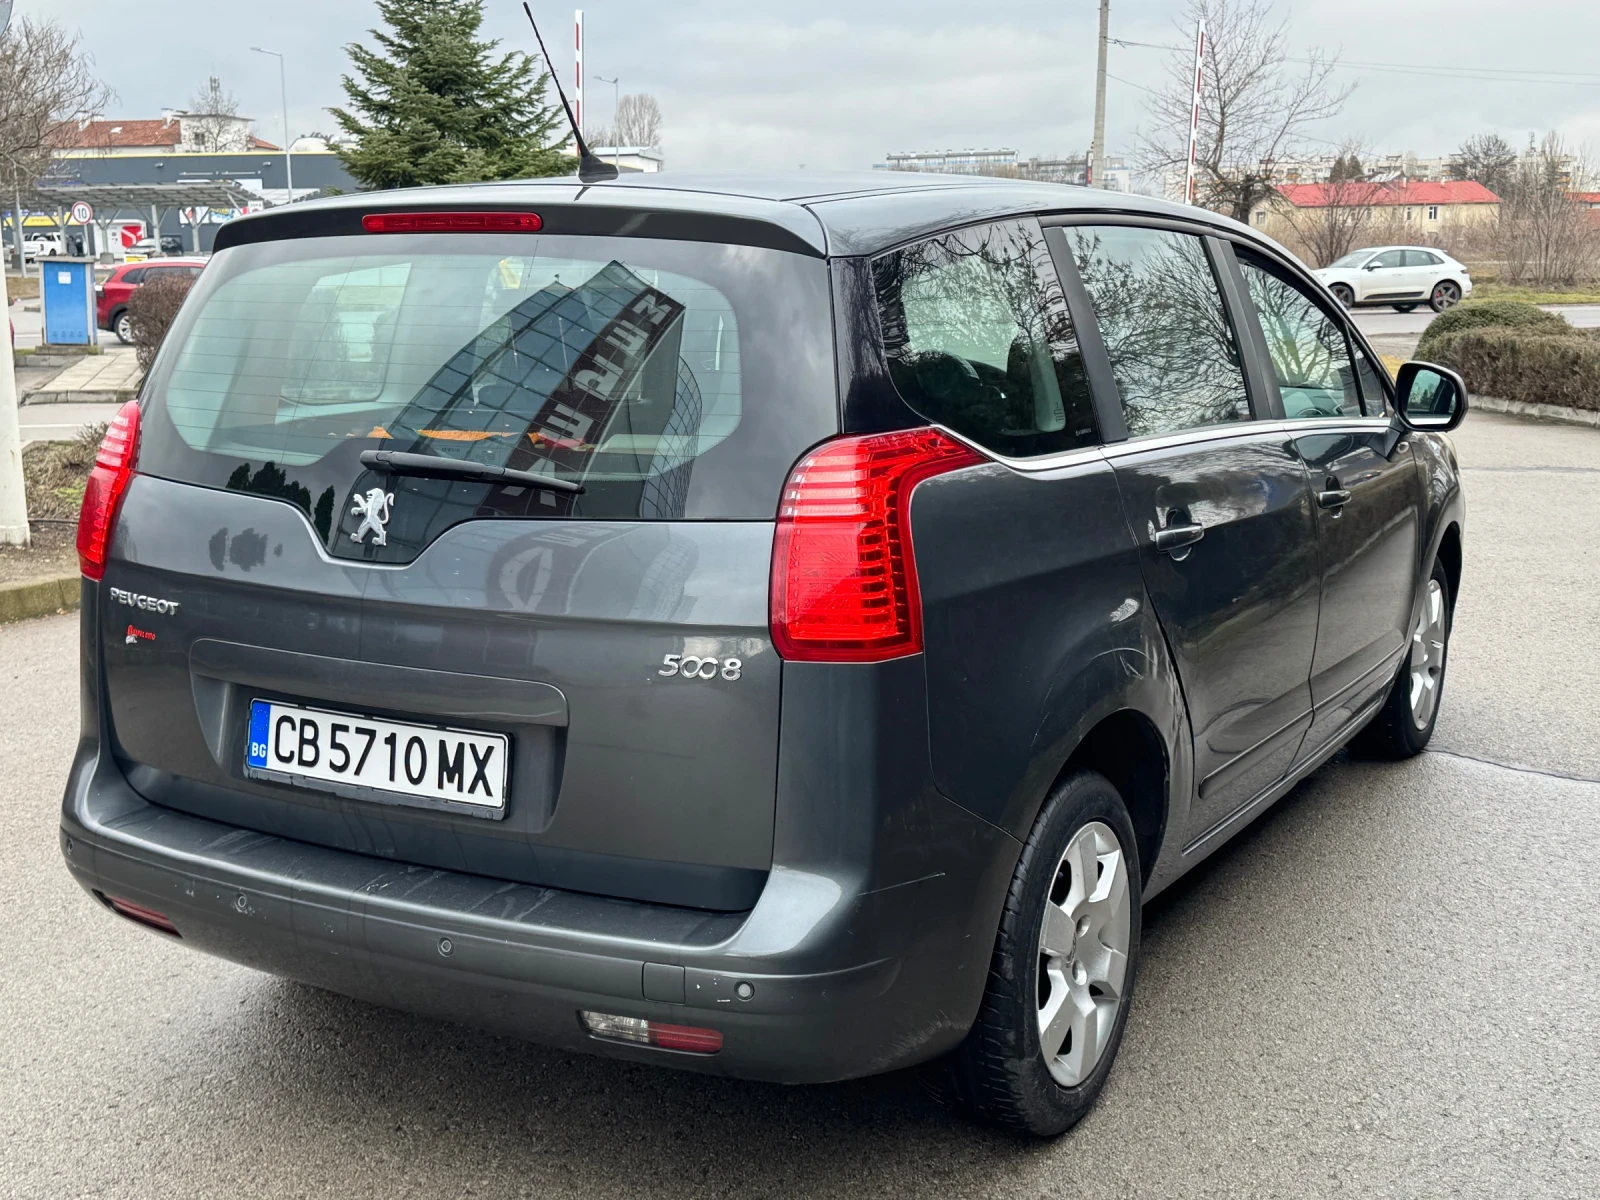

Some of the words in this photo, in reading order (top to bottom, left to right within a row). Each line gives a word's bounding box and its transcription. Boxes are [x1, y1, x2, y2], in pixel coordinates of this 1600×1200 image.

[77, 207, 88, 219] 10
[109, 587, 180, 616] PEUGEOT
[658, 654, 742, 681] 5008
[251, 742, 267, 758] BG
